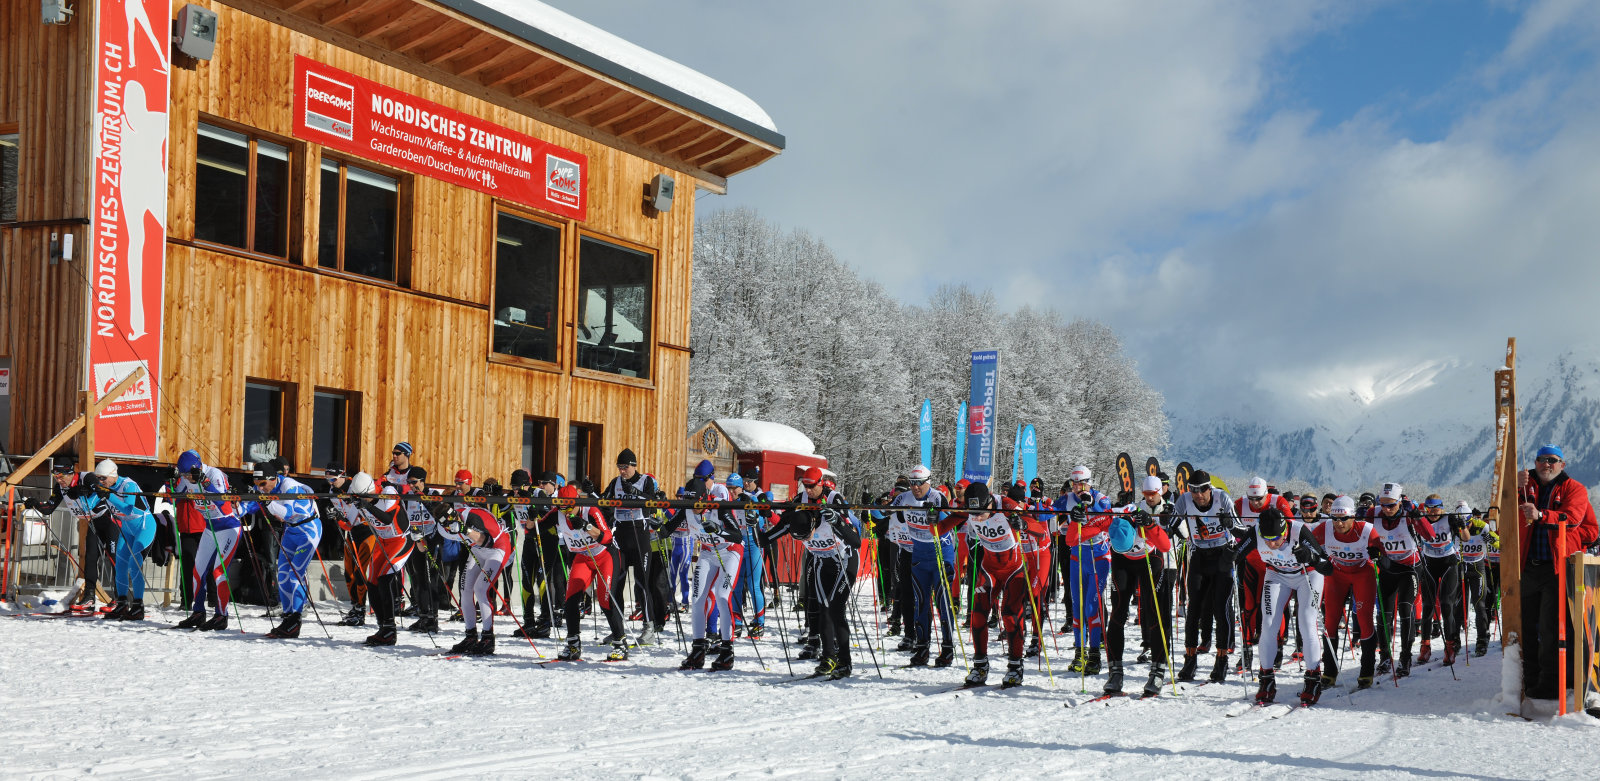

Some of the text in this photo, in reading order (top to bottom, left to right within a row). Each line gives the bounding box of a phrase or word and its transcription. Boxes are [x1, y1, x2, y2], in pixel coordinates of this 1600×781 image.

[308, 87, 352, 111] OBERGOMS
[371, 93, 532, 164] NORDISCHES ZENTRUM
[370, 118, 531, 181] Wachsraum/Kaffee- & Aufenthaltsraum
[370, 137, 481, 183] Garderoben/Duschen/WC
[97, 41, 122, 338] NORDISCHES-ZENTRUM.CH
[106, 403, 122, 412] Wallis
[125, 402, 146, 410] Schweiz
[975, 524, 1006, 538] 3086
[1194, 524, 1223, 536] 326
[1331, 550, 1364, 560] 3093
[693, 570, 701, 598] MADSHUS
[1264, 584, 1273, 616] MADSHUS
